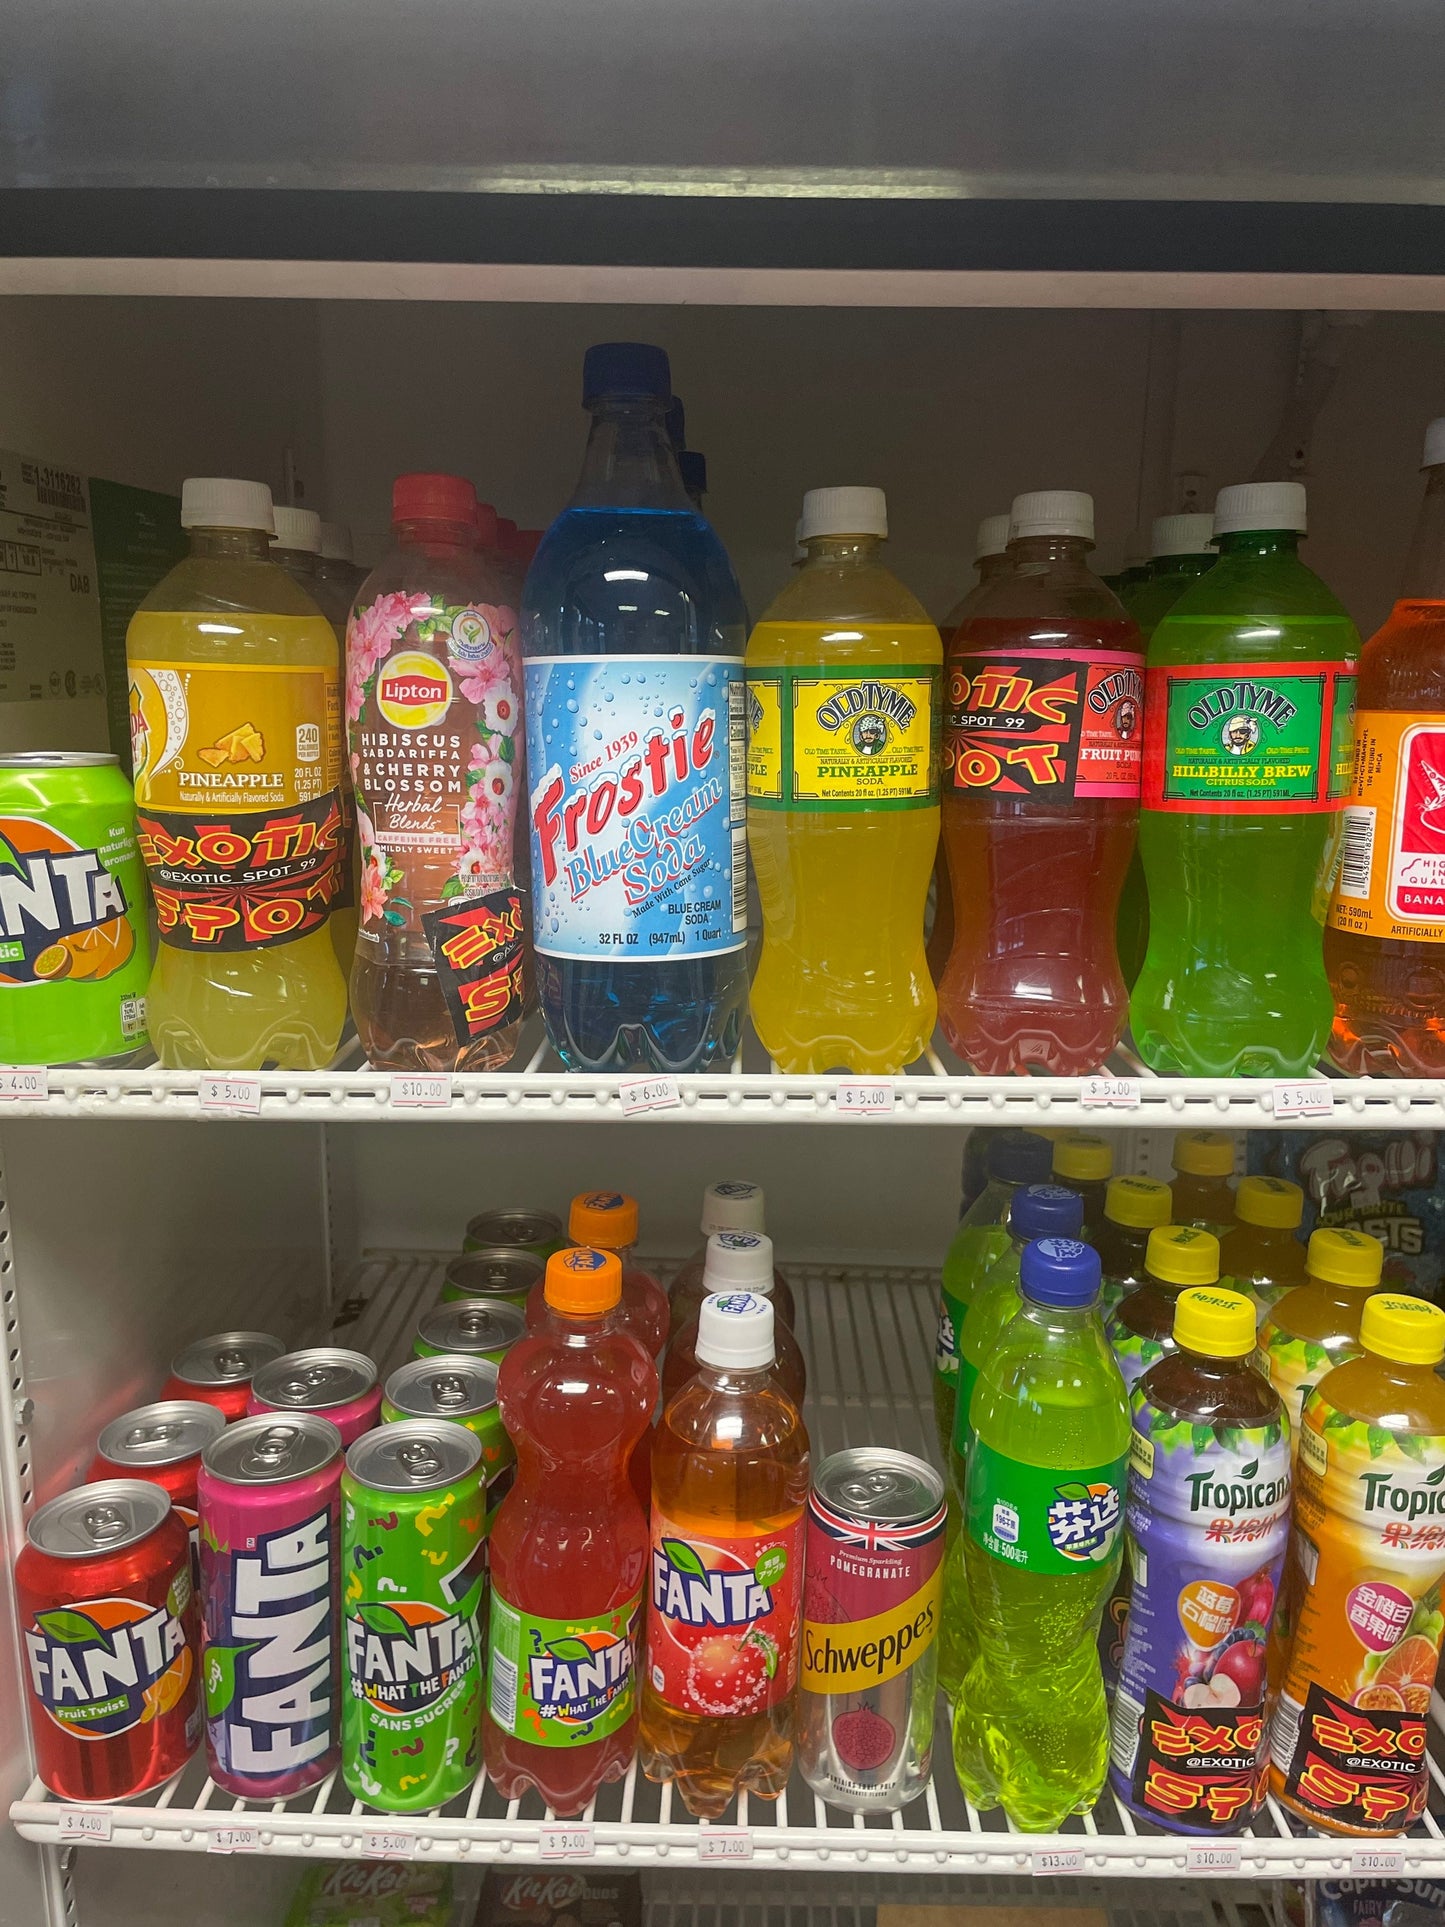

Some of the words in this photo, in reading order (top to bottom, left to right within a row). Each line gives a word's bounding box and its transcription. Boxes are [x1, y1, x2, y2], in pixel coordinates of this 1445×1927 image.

[384, 683, 442, 706] Lipton
[960, 716, 997, 726] SPOT
[1005, 717, 1025, 728] 99
[298, 728, 318, 743] 240
[361, 733, 461, 748] HIBISCUS
[362, 748, 460, 760] SABDARIFFA
[569, 755, 603, 783] Since
[603, 731, 639, 762] 1939
[1080, 748, 1123, 761] FRUIT
[294, 767, 304, 778] 20
[305, 767, 313, 777] FL
[314, 766, 322, 777] OZ
[363, 762, 371, 776] &
[375, 763, 461, 778] CHERRY
[816, 763, 919, 778] PINEAPPLE
[1172, 765, 1260, 778] HILLBILLY
[1263, 765, 1312, 778] BREW
[178, 772, 284, 788] PINEAPPLE
[294, 780, 311, 792] (1.25
[364, 778, 462, 793] BLOSSOM
[856, 777, 884, 786] SODA
[179, 791, 204, 803] Naturally
[205, 792, 211, 801] &
[211, 791, 243, 802] Artificially
[243, 791, 269, 802] Flavored
[270, 791, 285, 803] Soda
[530, 705, 717, 888] Frostie
[821, 789, 831, 798] Net
[831, 789, 855, 798] Contents
[855, 789, 863, 798] 20
[876, 788, 889, 799] (1.25
[889, 787, 898, 798] PT)
[384, 793, 443, 814] Herbal
[388, 813, 437, 831] Blends
[108, 825, 126, 839] Kun
[377, 834, 427, 845] CAFFEINE
[428, 835, 458, 845] FREE
[137, 820, 344, 867] EXOTIC
[564, 841, 635, 903] Blue
[625, 777, 724, 859] Cream
[380, 844, 414, 854] MILDLY
[416, 845, 454, 856] SWEET
[245, 865, 292, 882] SPOT
[300, 857, 317, 869] 99
[622, 833, 706, 906] Soda
[1423, 859, 1445, 869] HIG
[1409, 876, 1445, 885] QUAL
[1432, 869, 1444, 877] IN
[0, 854, 125, 936] NTA
[631, 901, 653, 919] Made
[653, 887, 673, 909] With
[673, 874, 693, 894] Cane
[692, 857, 712, 882] Sugar
[668, 902, 693, 915] BLUE
[693, 900, 722, 914] CREAM
[1336, 906, 1348, 915] NET:
[1348, 906, 1373, 920] 590mL
[685, 913, 709, 926] SODA
[598, 933, 611, 945] 32
[613, 933, 625, 945] FL
[626, 933, 639, 945] OZ
[648, 931, 686, 945] (947mL)
[695, 930, 700, 942] 1
[701, 927, 722, 942] Quart
[1391, 925, 1444, 938] ARTIFICIALLY
[10, 1076, 38, 1091] 4.00
[401, 1081, 442, 1097] $10.00
[642, 1082, 669, 1100] 6.00
[1103, 1081, 1131, 1096] 5.00
[224, 1085, 251, 1100] 5.00
[859, 1090, 885, 1105] 5.00
[1296, 1091, 1322, 1106] 5.00
[1048, 1488, 1119, 1546] 芬达
[839, 1550, 869, 1564] Premium
[869, 1556, 904, 1567] Sparkling
[830, 1555, 911, 1579] POMEGRANATE
[653, 1553, 771, 1622] FANTA
[1355, 1585, 1413, 1624] 金橙百
[1181, 1598, 1235, 1634] 石榴味
[1350, 1604, 1403, 1644] 香果味
[230, 1512, 331, 1773] FANTA
[804, 1600, 934, 1675] Schweppes
[24, 1608, 187, 1700] FANTA
[346, 1614, 473, 1682] FANTA
[530, 1640, 632, 1701] FANTA
[351, 1675, 408, 1702] #WHAT
[409, 1680, 440, 1698] THE
[441, 1656, 477, 1689] FANTA
[368, 1711, 412, 1732] SANS
[413, 1680, 467, 1730] SUCRES
[539, 1700, 589, 1719] #WHAT
[588, 1694, 608, 1710] THE
[606, 1678, 630, 1701] FANTA
[57, 1708, 88, 1719] Fruit
[88, 1699, 126, 1717] Twist
[1346, 1757, 1416, 1773] @EXOTIC
[79, 1816, 102, 1831] 4.00
[227, 1830, 251, 1844] 7.00
[381, 1835, 408, 1849] 5.00
[561, 1834, 585, 1848] 9.00
[720, 1839, 745, 1854] 7.00
[1041, 1855, 1077, 1867] $13.00
[1196, 1852, 1232, 1864] $10.00
[1360, 1855, 1397, 1868] $10.00
